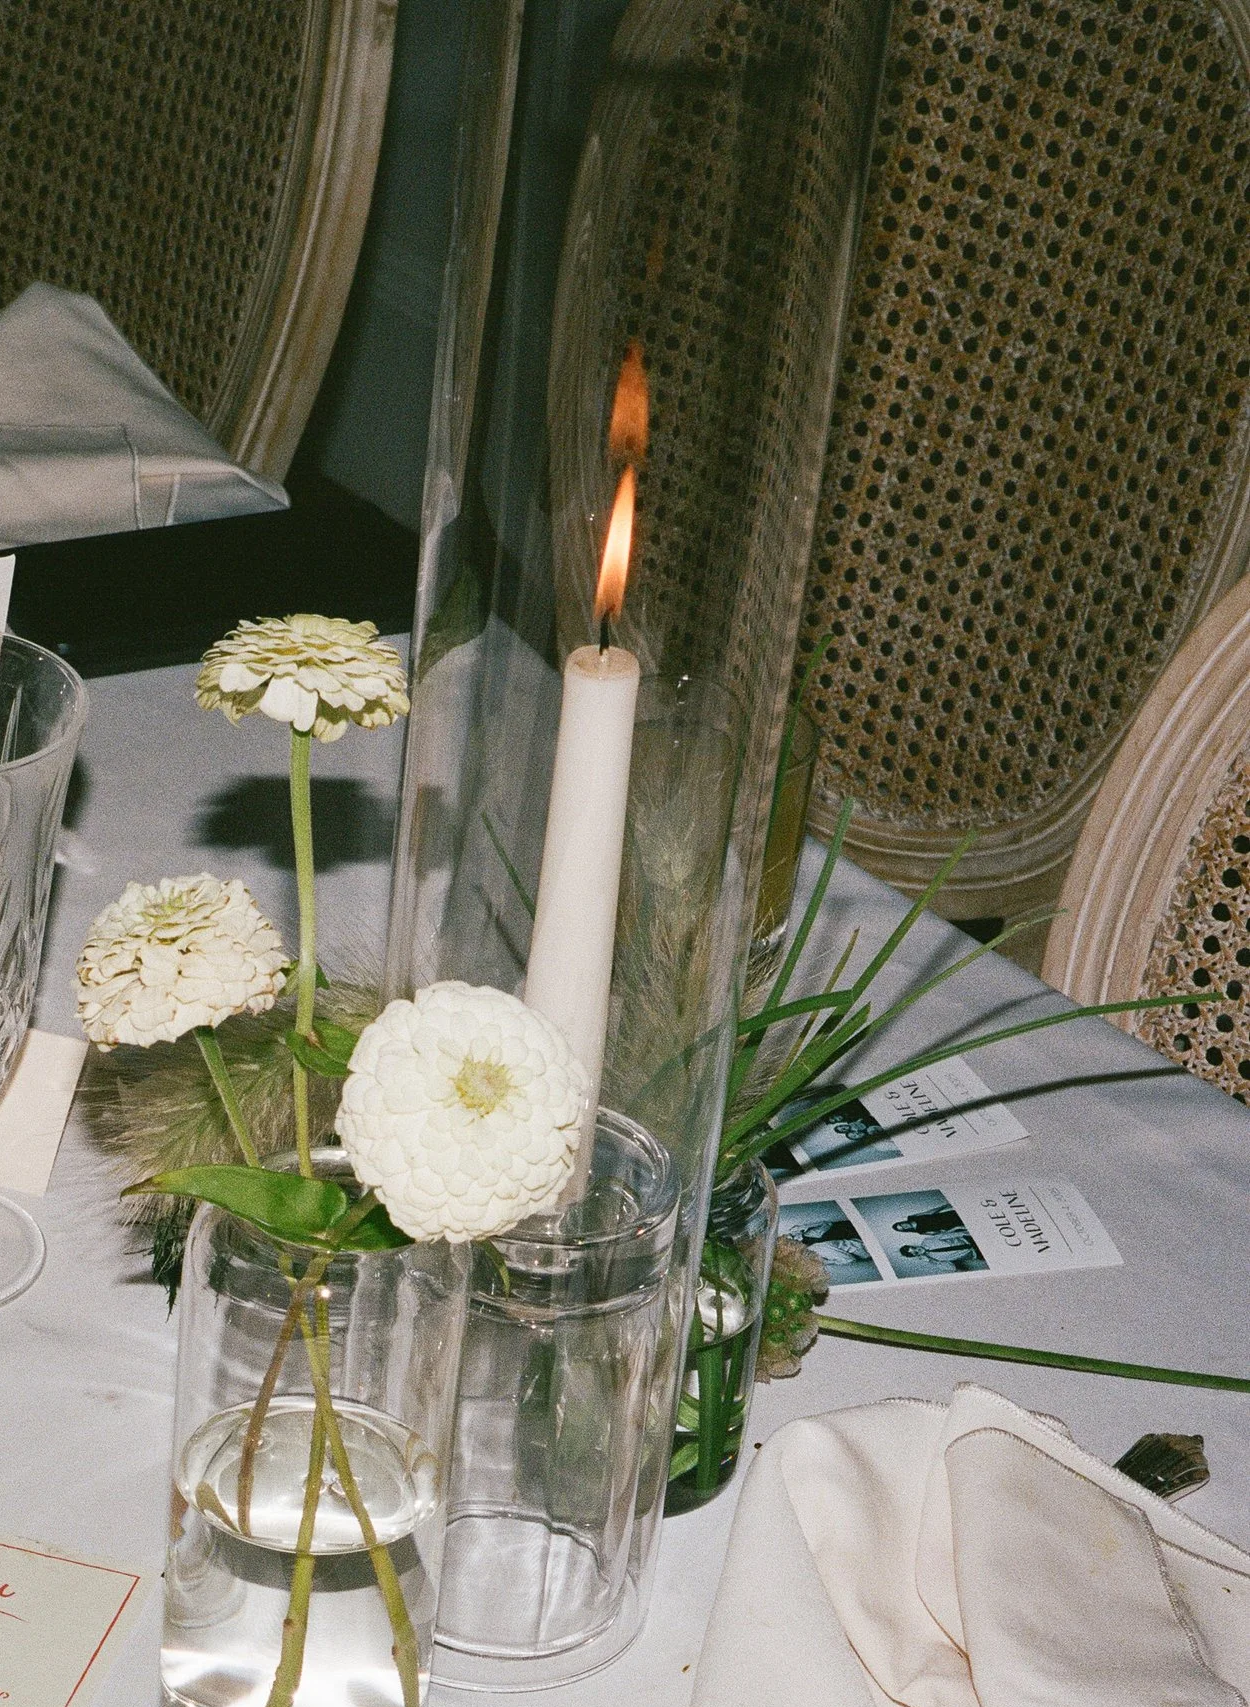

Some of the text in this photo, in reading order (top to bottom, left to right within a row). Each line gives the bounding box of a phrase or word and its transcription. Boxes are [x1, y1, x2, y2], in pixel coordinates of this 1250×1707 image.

[980, 1199, 1022, 1247] COLE &
[999, 1190, 1050, 1254] MADELINE
